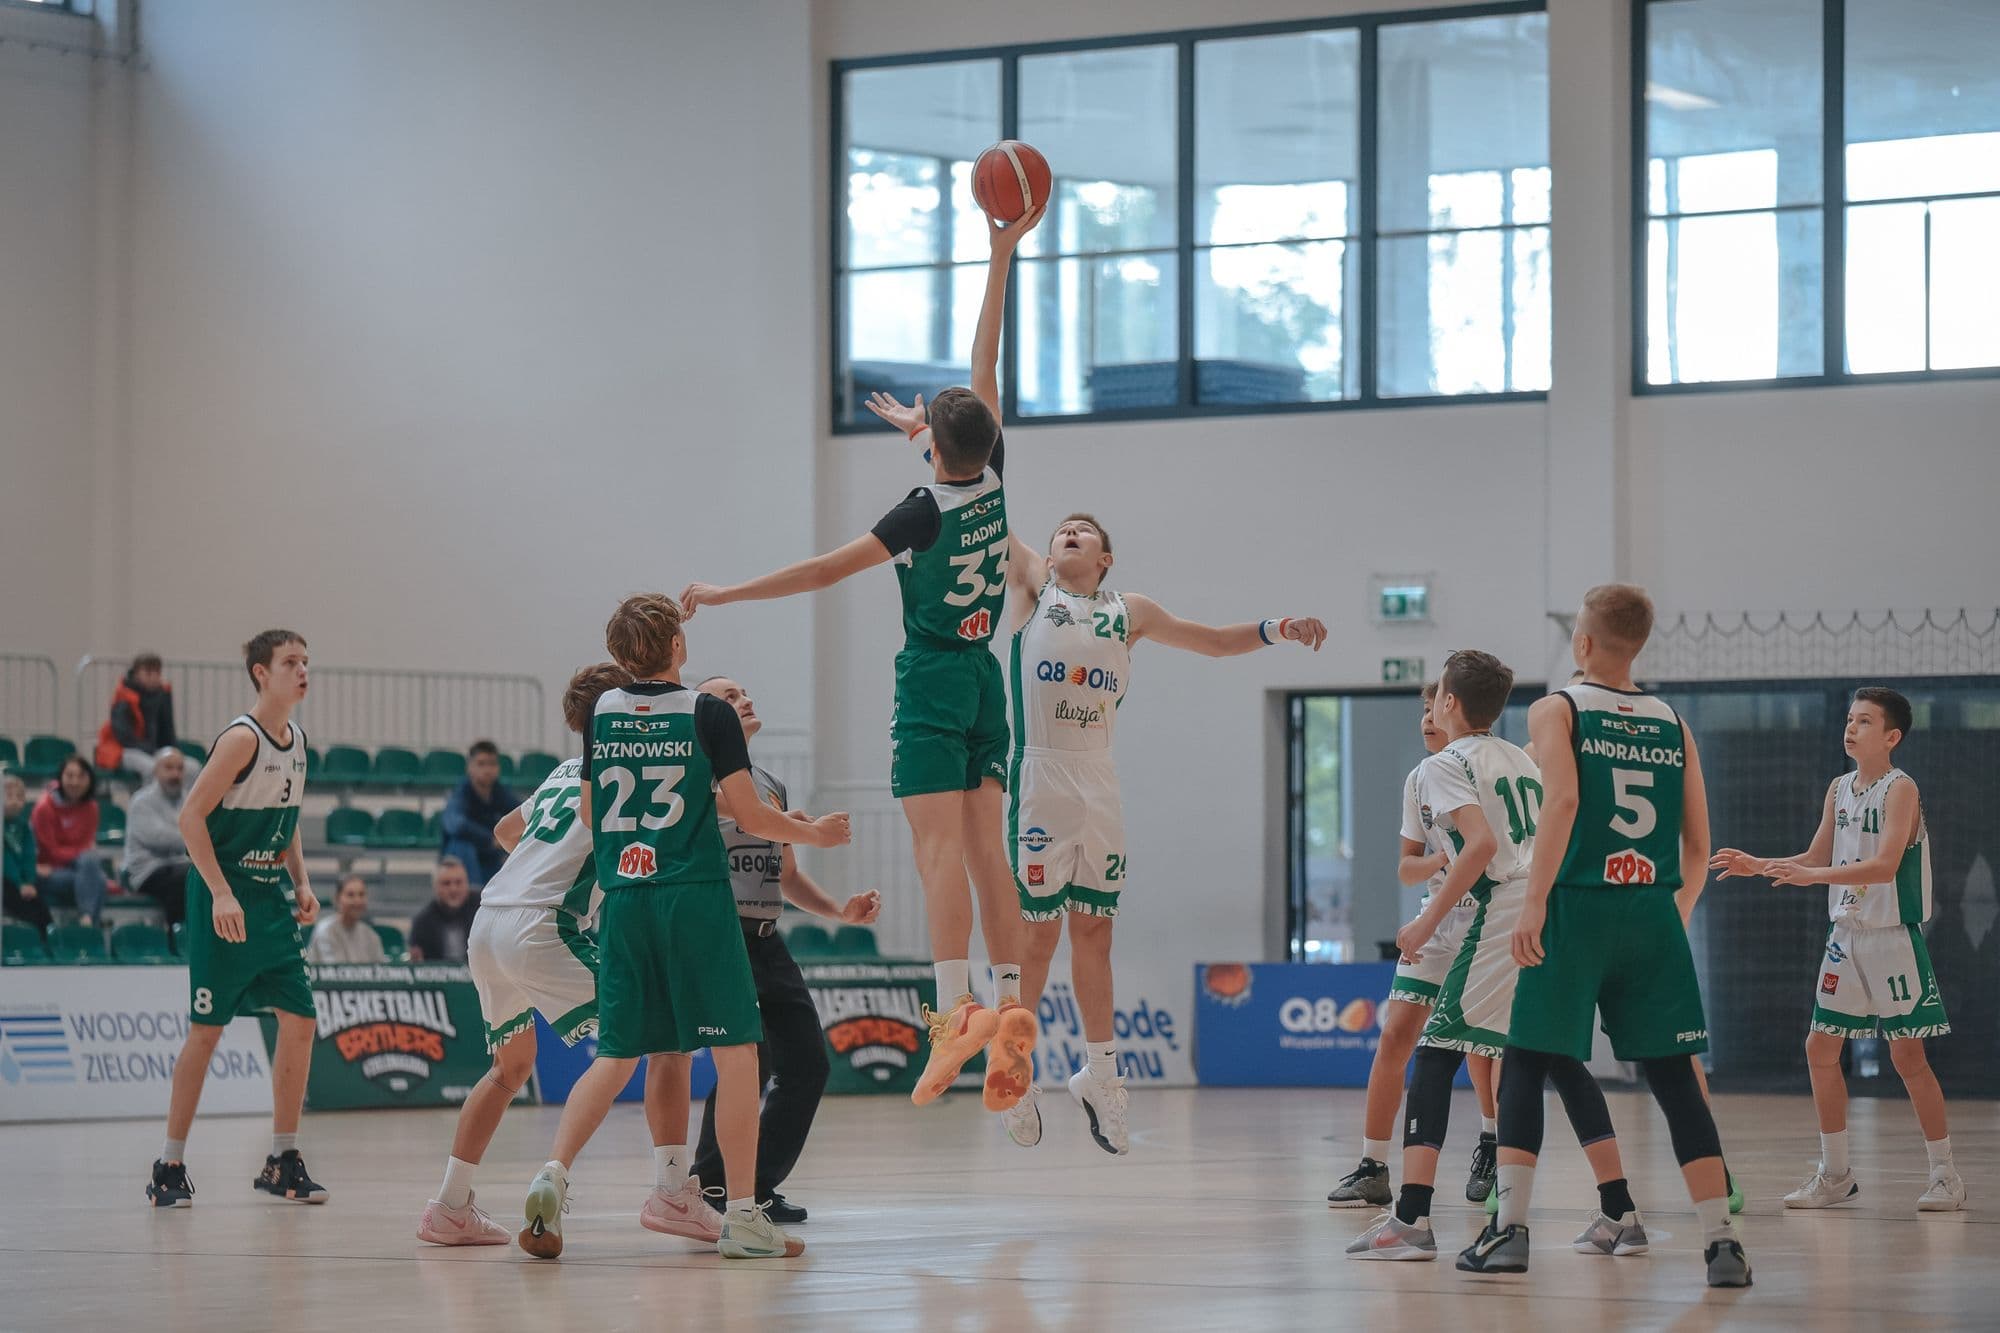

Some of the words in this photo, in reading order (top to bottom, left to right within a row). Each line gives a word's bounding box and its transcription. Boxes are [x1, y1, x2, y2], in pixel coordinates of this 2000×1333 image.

[961, 518, 1003, 548] RADNY
[943, 535, 1010, 607] 33
[1093, 611, 1126, 643] 24
[1037, 660, 1066, 682] Q8
[1088, 667, 1118, 693] Oils
[1055, 699, 1100, 729] iluzja
[592, 740, 693, 760] ŻYZNOWSKI
[1581, 737, 1684, 767] ANDRAŁOJĆ
[520, 785, 581, 845] 55
[598, 765, 686, 833] 23
[1494, 775, 1544, 845] 10
[1608, 767, 1657, 839] 5
[1862, 808, 1879, 834] 11
[194, 987, 213, 1015] 8
[1887, 974, 1912, 1001] 11
[312, 990, 457, 1040] BASKETBALL
[1038, 985, 1079, 1036] pij
[1113, 997, 1181, 1051] odę
[1279, 997, 1338, 1033] Q8
[69, 1012, 191, 1042] WODOCI
[698, 1026, 727, 1036] PEHA
[1676, 1030, 1709, 1044] PEHA
[1063, 1041, 1165, 1080] knu
